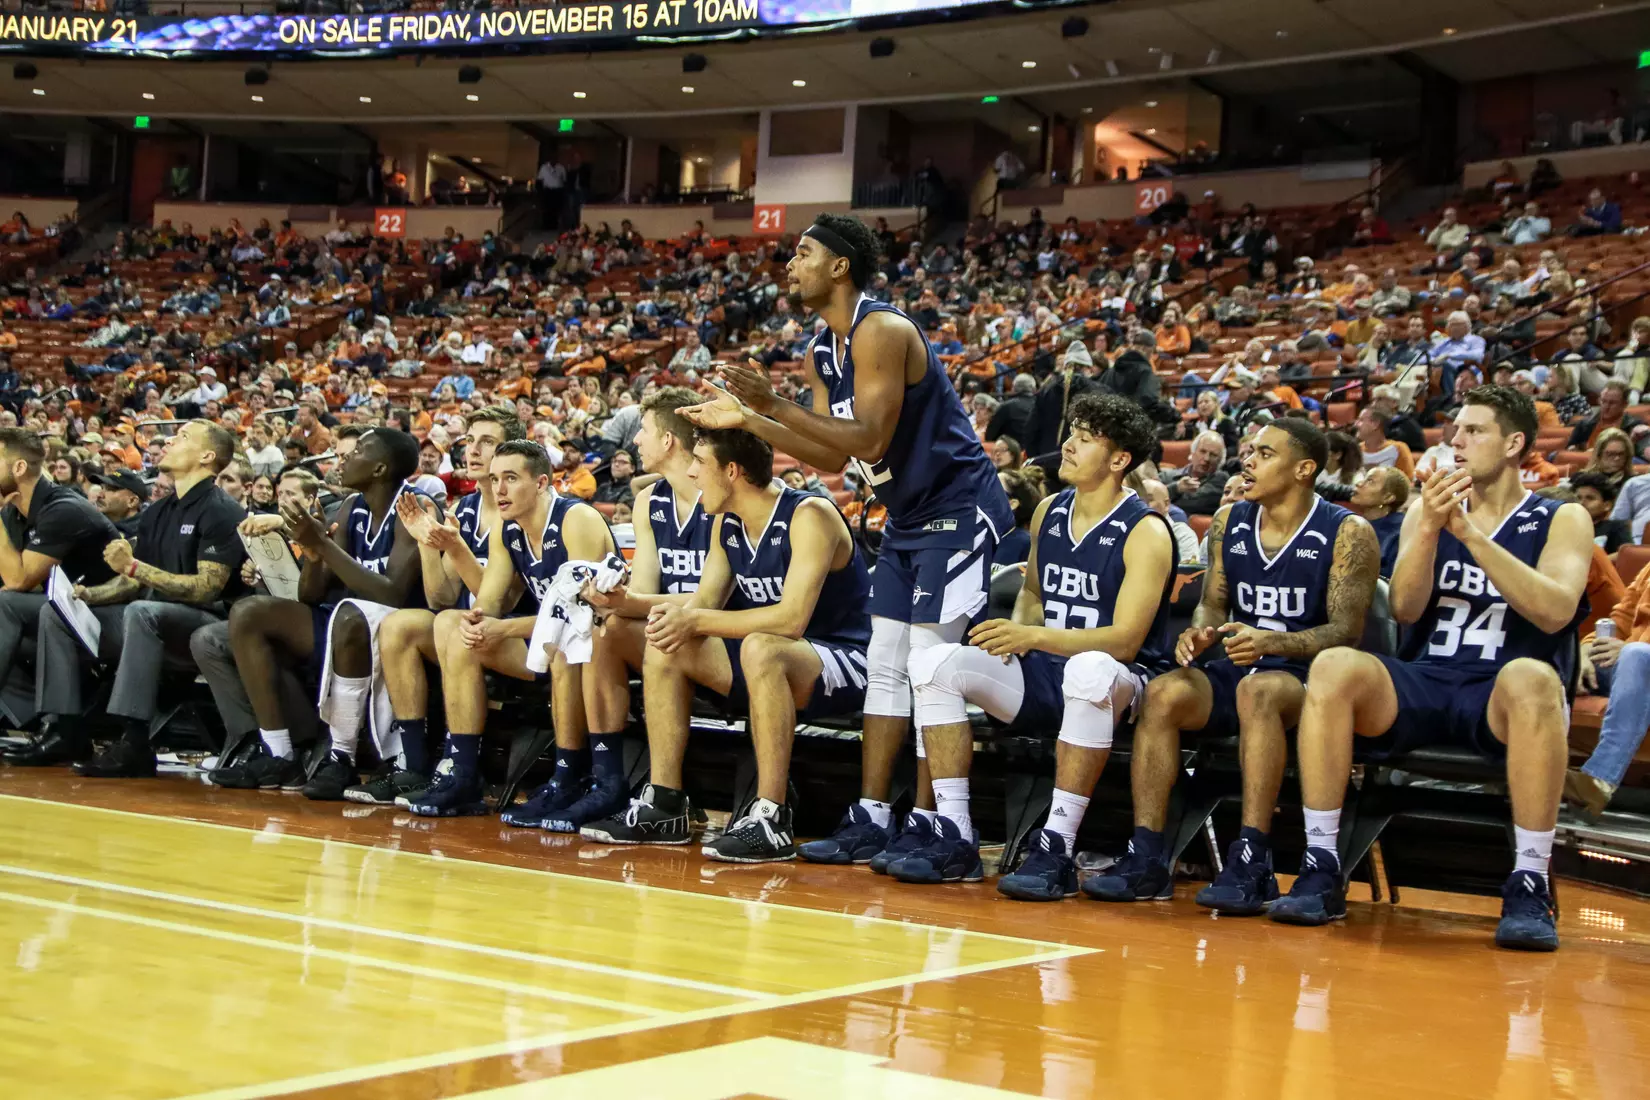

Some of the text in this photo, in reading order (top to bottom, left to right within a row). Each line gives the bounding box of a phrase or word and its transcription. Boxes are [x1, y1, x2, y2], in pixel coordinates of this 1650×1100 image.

[110, 18, 137, 43] 21
[279, 0, 758, 43] ON SALE FRIDAY, NOVEMBER 15 AT 10AM
[1139, 187, 1167, 209] 20
[379, 214, 401, 232] 22
[758, 209, 781, 229] 21
[1098, 535, 1116, 546] WAC
[1517, 521, 1540, 535] WAC
[658, 548, 706, 577] CBU
[1296, 548, 1320, 560] WAC
[735, 573, 784, 603] CBU
[1043, 562, 1100, 602] CBU
[1237, 581, 1307, 618] CBU
[1427, 595, 1509, 661] 34
